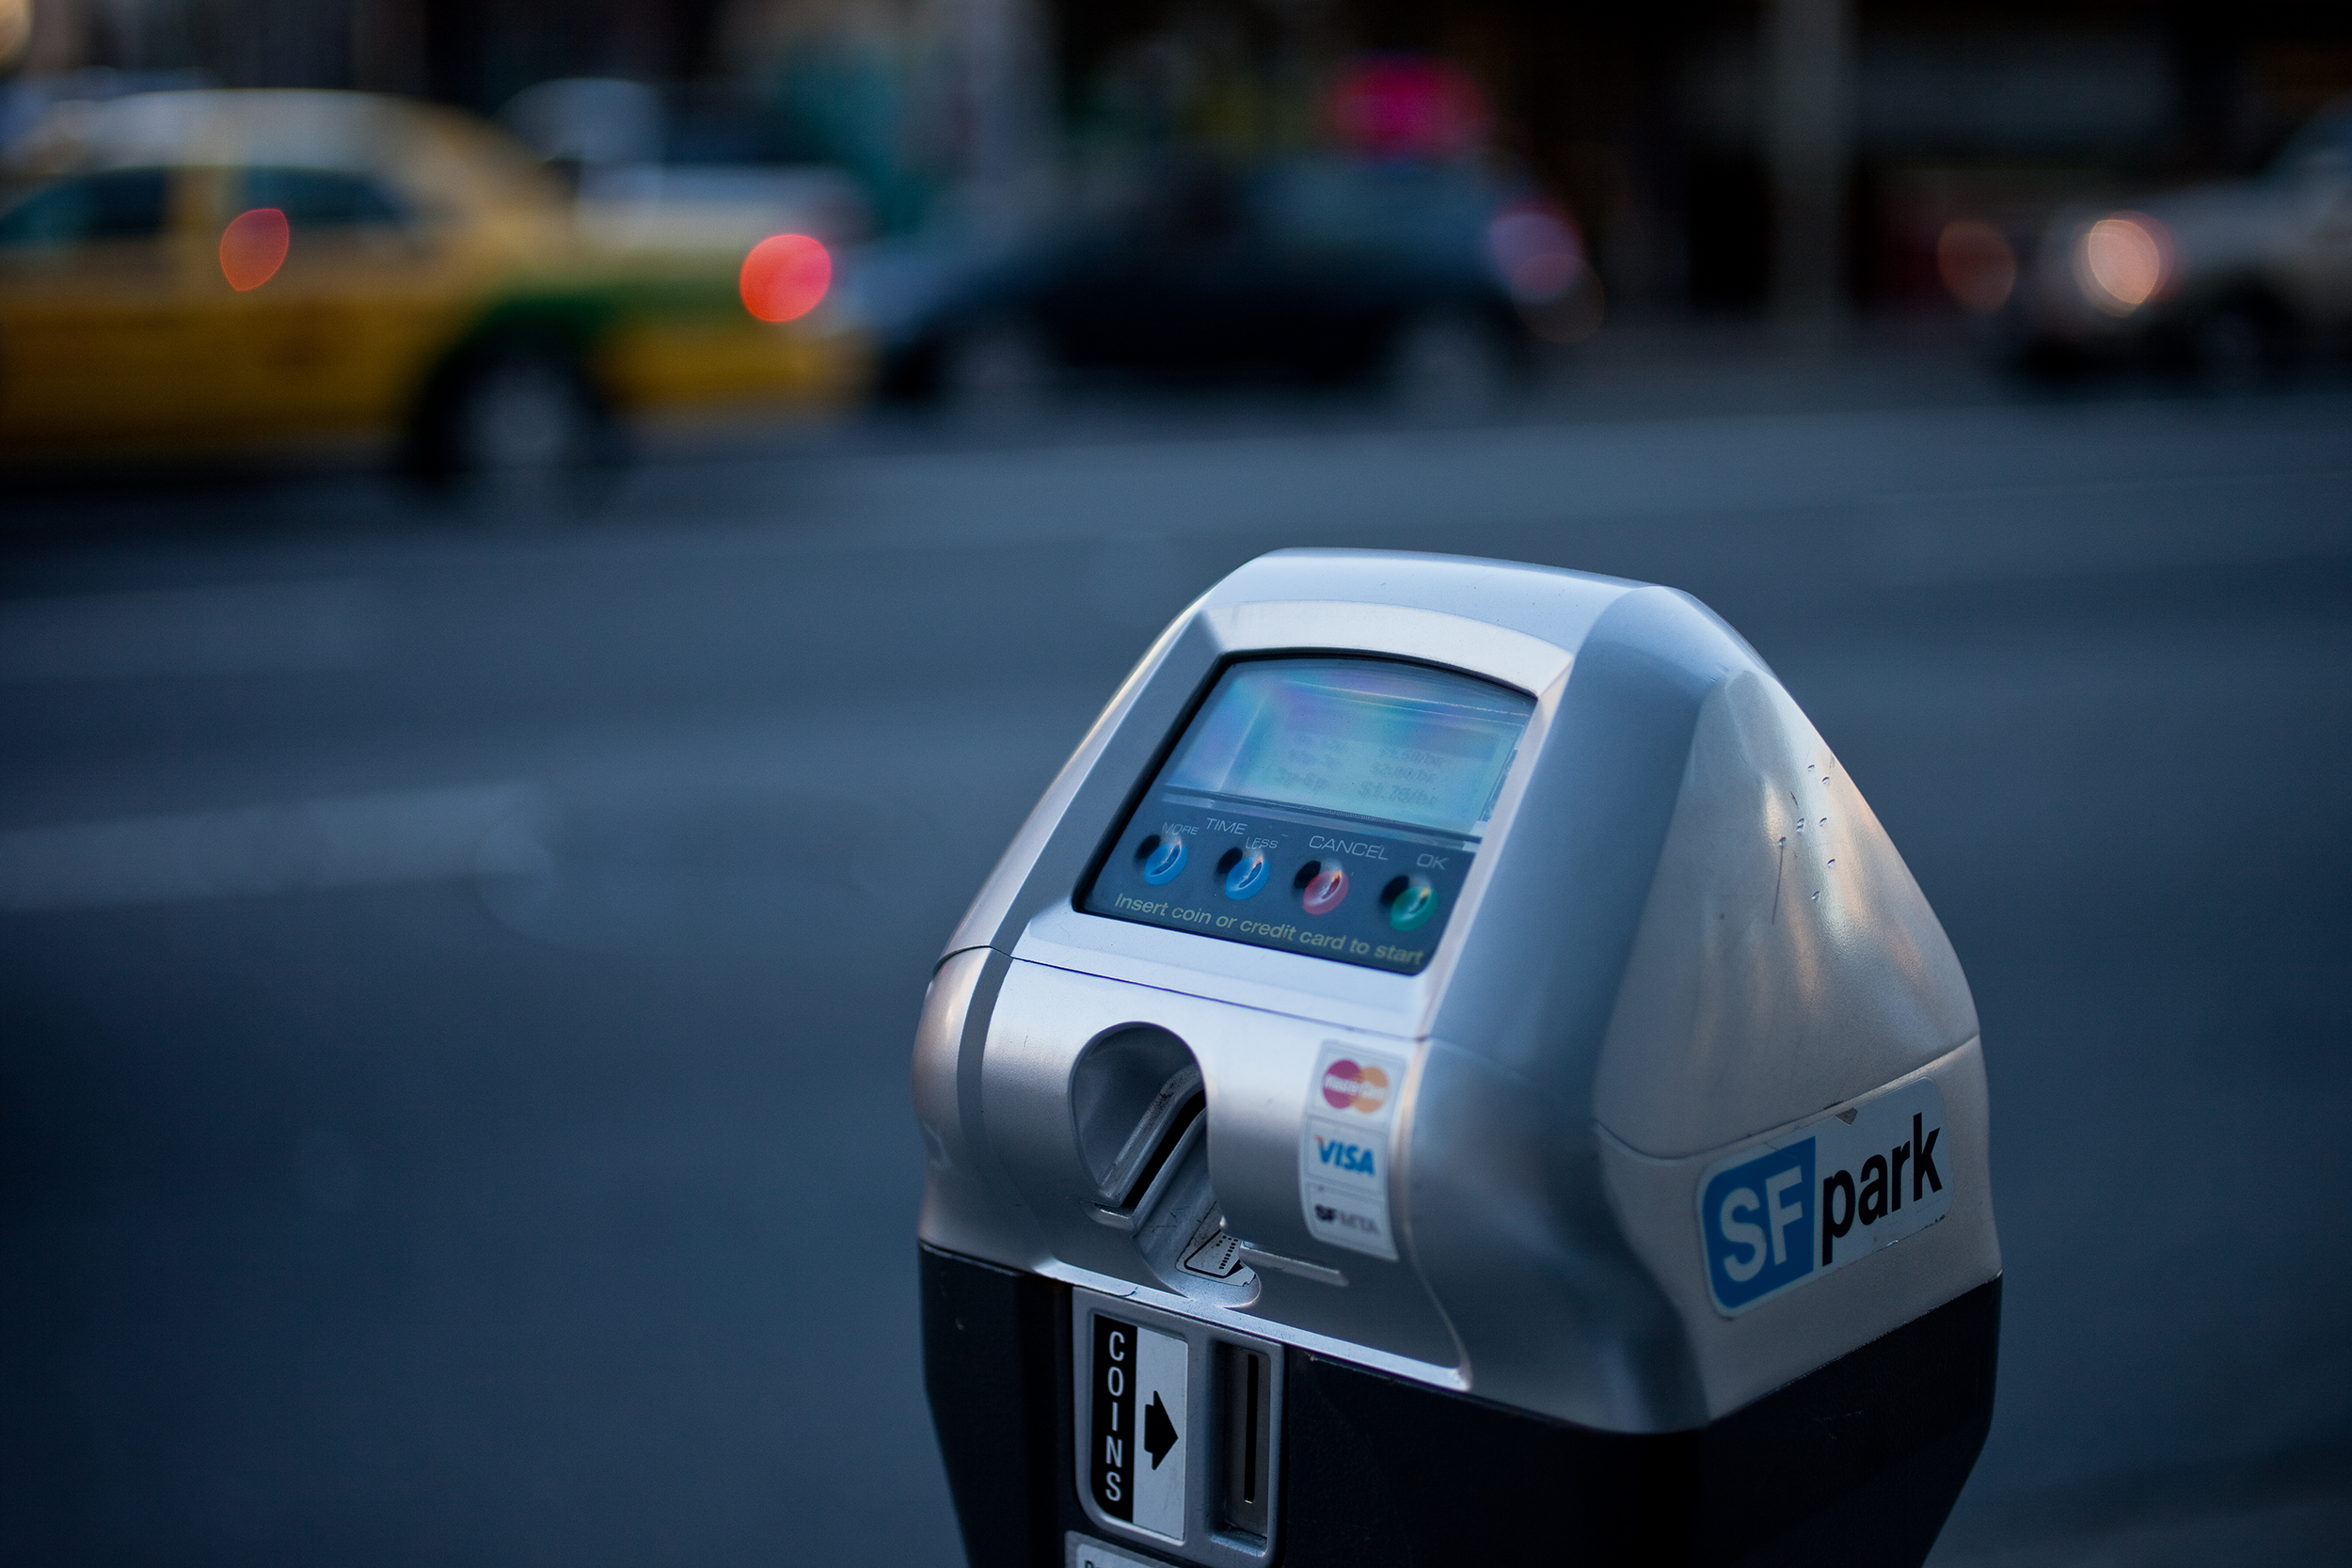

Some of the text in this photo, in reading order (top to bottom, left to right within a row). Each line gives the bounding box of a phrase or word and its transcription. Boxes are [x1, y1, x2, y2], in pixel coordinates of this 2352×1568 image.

[1162, 821, 1200, 836] MORE
[1206, 816, 1248, 835] TIME
[1245, 836, 1279, 850] LESS
[1309, 835, 1389, 861] CANCEL
[1417, 853, 1450, 871] OK
[1114, 893, 1424, 966] Insert coin or credit card to start
[1315, 1135, 1375, 1177] VISA
[1105, 1331, 1125, 1502] COINS
